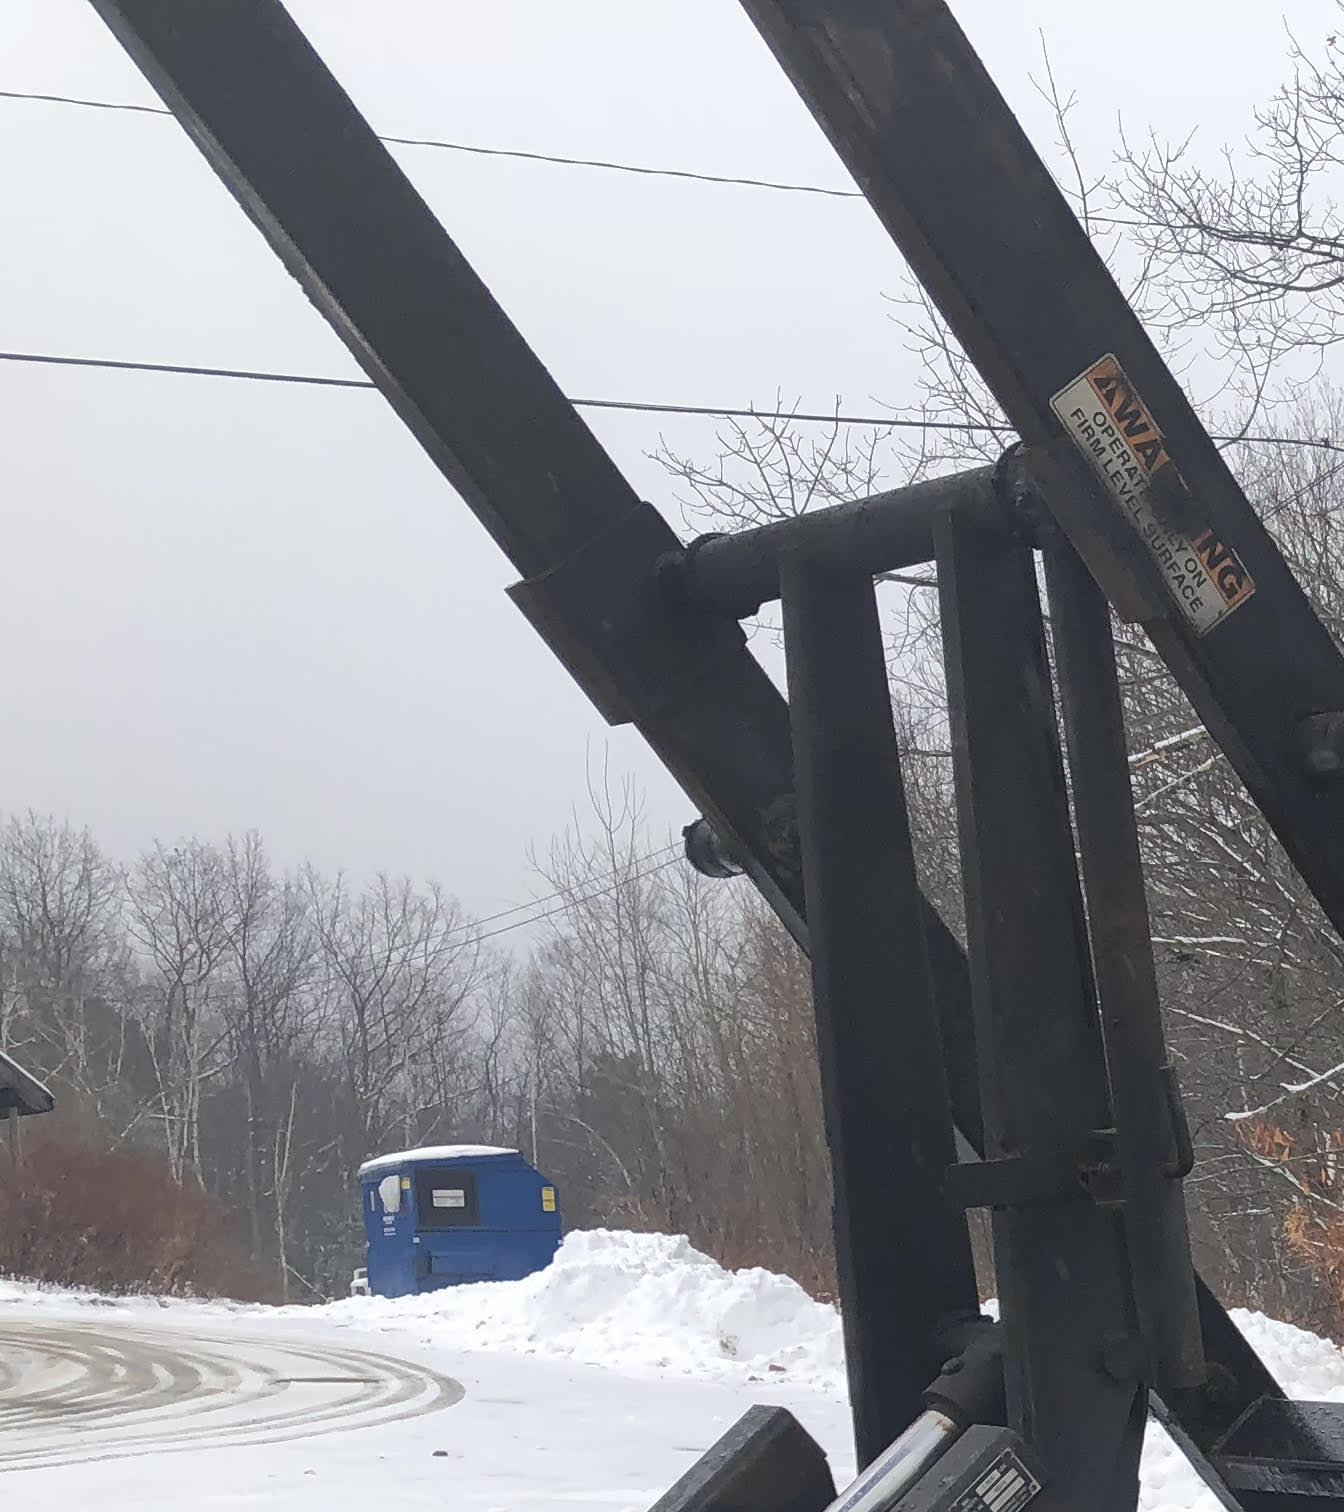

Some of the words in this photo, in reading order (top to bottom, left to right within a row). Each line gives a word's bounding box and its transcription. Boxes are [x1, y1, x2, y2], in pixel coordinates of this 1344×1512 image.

[1070, 407, 1106, 458] FIRM
[1103, 458, 1143, 522] LEVEL
[1142, 523, 1204, 614] SURFACE
[1091, 410, 1148, 495] OPERAT
[1184, 556, 1207, 589] ON
[1113, 402, 1244, 599] WANG
